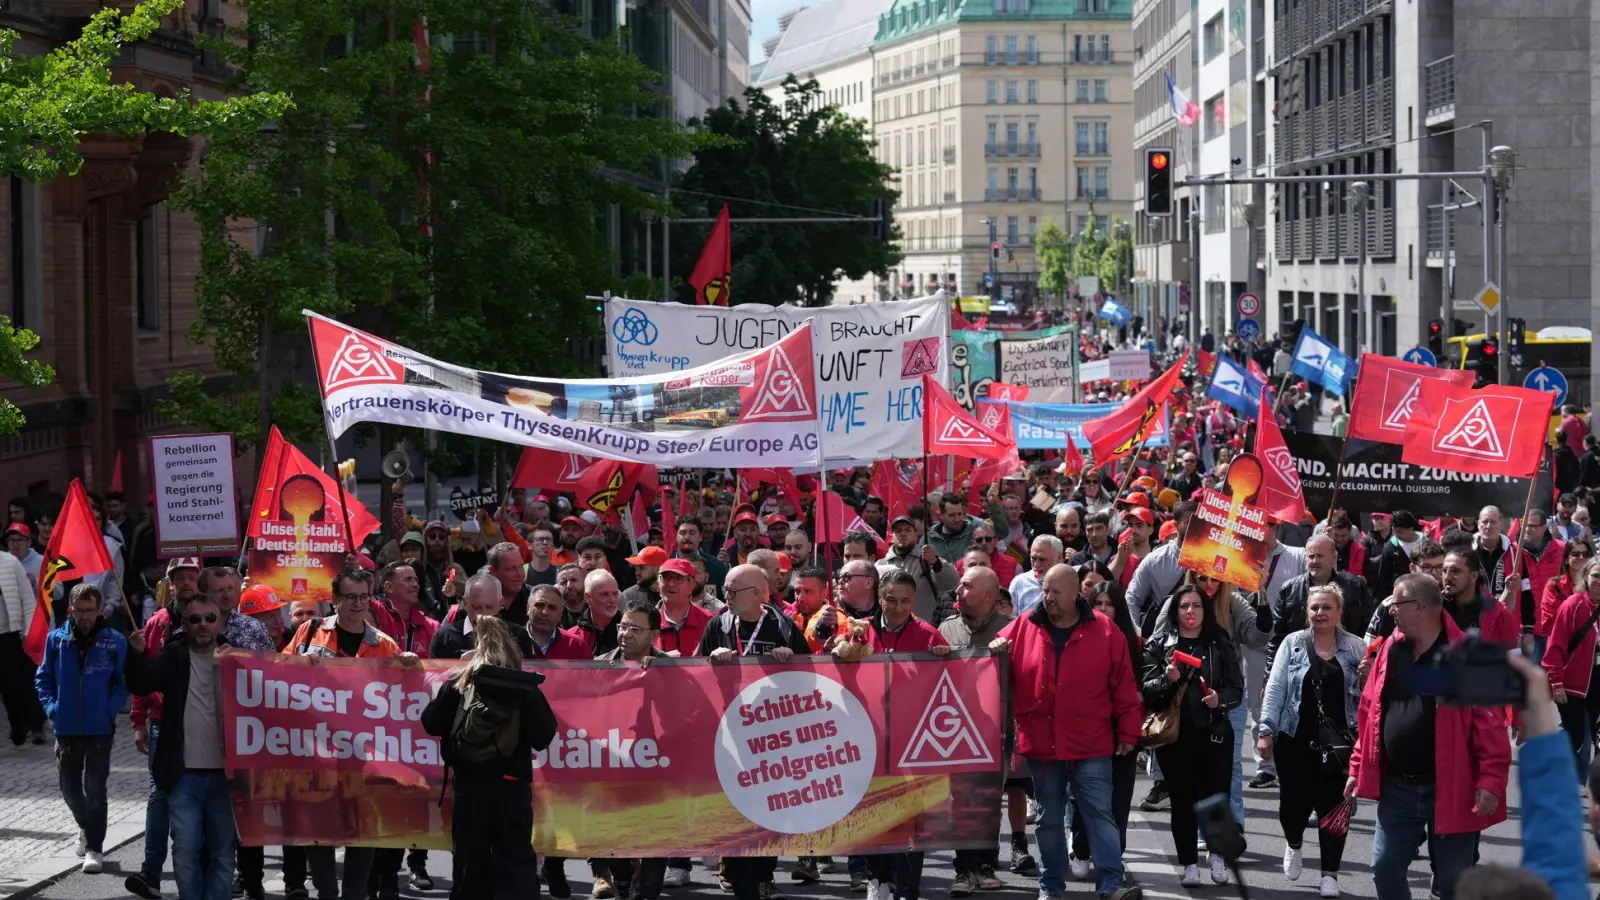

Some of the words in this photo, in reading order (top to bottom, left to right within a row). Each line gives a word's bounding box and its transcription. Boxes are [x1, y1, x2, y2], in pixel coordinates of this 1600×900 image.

[1243, 299, 1256, 310] 30
[694, 315, 804, 349] JUGEN
[830, 315, 921, 342] BRAUCHT
[819, 349, 893, 382] UNFT
[820, 391, 869, 434] HME
[328, 394, 495, 423] Vertrauenskörper
[501, 410, 650, 454] ThyssenKrupp
[656, 438, 702, 454] Steel
[709, 435, 784, 457] Europe
[788, 432, 818, 451] AG
[164, 443, 216, 456] Rebellion
[165, 456, 218, 469] gemeinsam
[1337, 462, 1414, 481] MACHT.
[170, 471, 199, 482] gegen
[201, 470, 215, 479] die
[659, 472, 696, 484] TREITAXT
[165, 482, 223, 497] Regierung
[1328, 481, 1403, 493] ACELORMITTAL
[1405, 485, 1451, 494] DUISBURG
[167, 498, 189, 509] und
[191, 497, 224, 508] Stahl-
[1205, 491, 1234, 513] Unser
[1237, 502, 1265, 525] Stahl.
[168, 511, 224, 523] konzerne!
[1198, 506, 1265, 541] Deutschlands
[261, 523, 298, 536] Unser
[302, 523, 341, 537] Stahl.
[1208, 527, 1244, 552] Stärke.
[257, 537, 345, 553] Deutschlands
[276, 554, 324, 568] Stärke.
[236, 669, 353, 715] Unser
[363, 680, 443, 721] Sta
[739, 687, 833, 727] Schützt,
[236, 716, 445, 766] Deutschla
[747, 730, 793, 755] was
[796, 719, 838, 744] uns
[737, 741, 861, 788] erfolgreich
[767, 773, 844, 812] macht!
